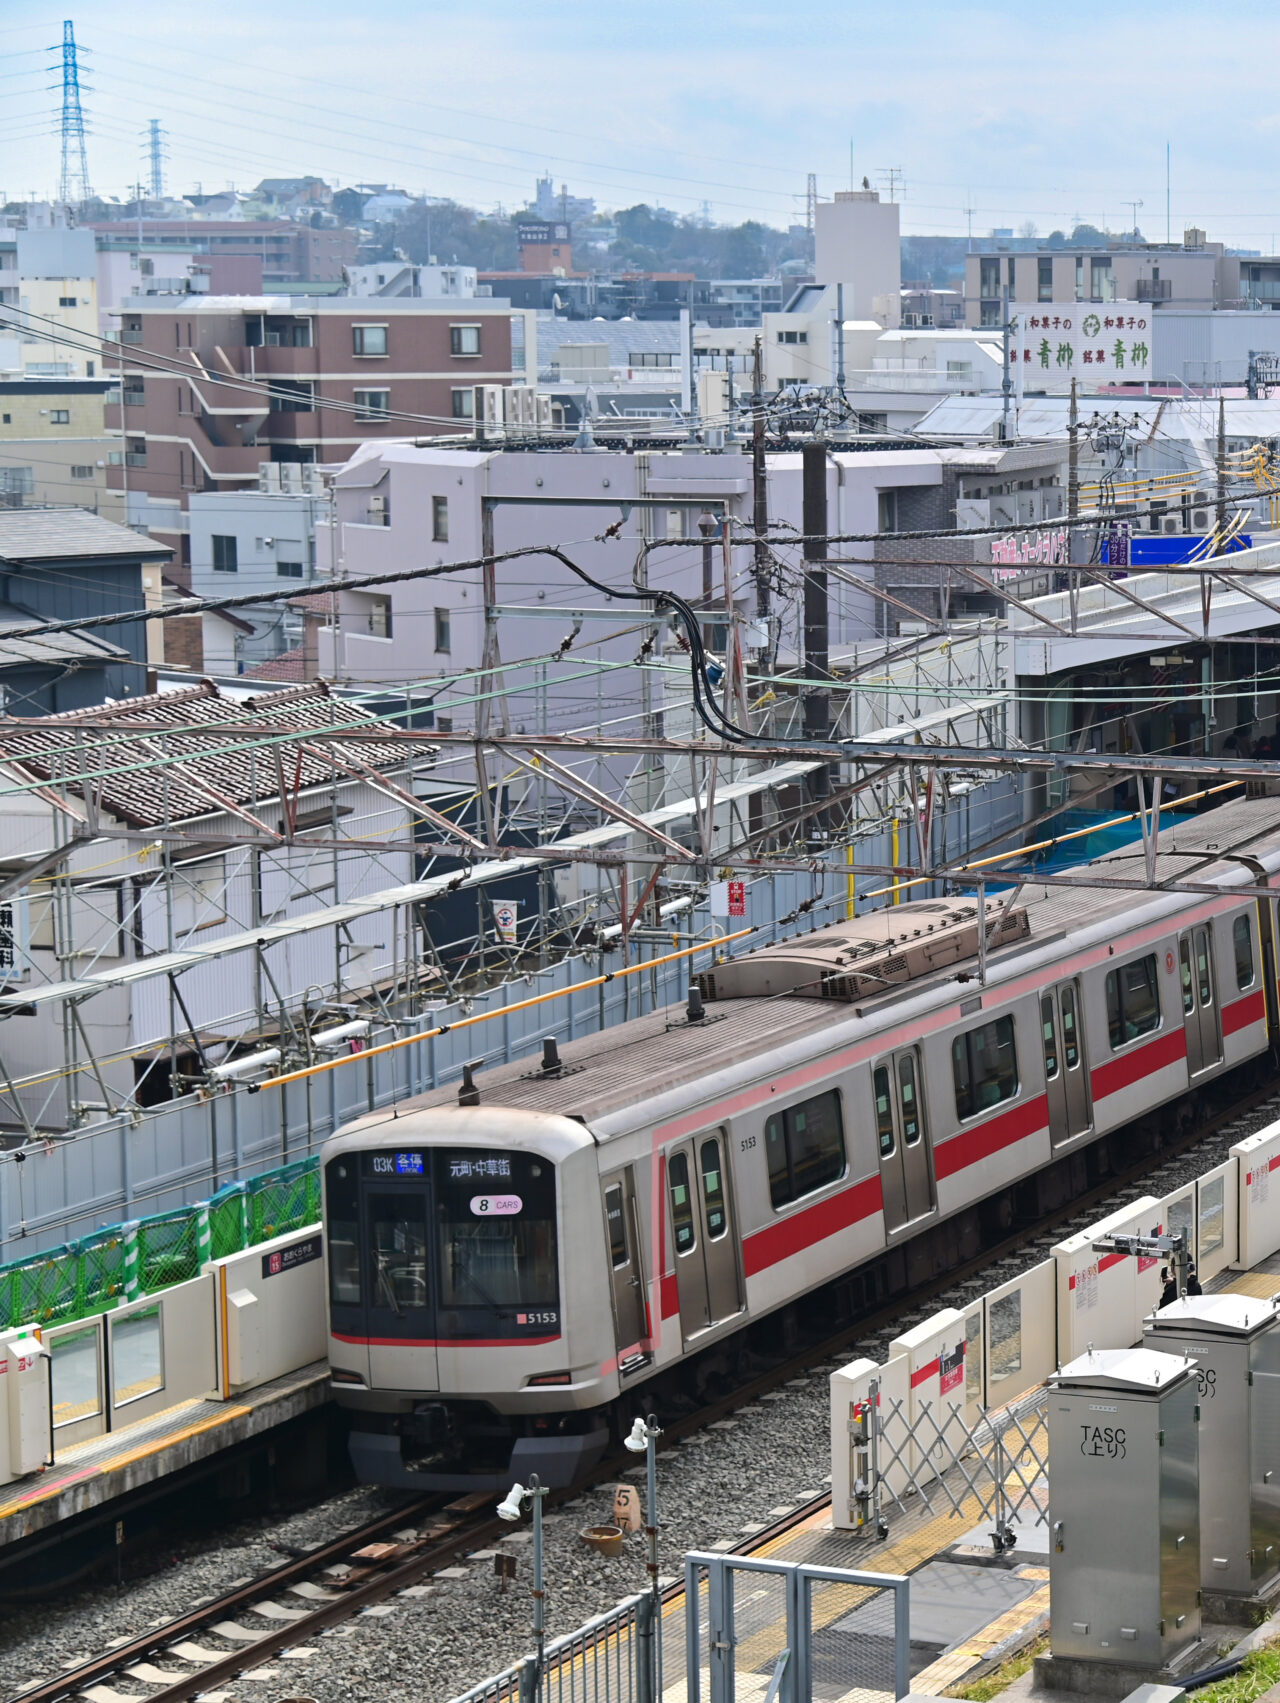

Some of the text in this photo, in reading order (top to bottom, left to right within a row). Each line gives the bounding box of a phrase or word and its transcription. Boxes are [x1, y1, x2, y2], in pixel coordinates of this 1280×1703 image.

[1029, 315, 1072, 330] 和菓子の
[1103, 315, 1147, 330] 和菓子の
[741, 1135, 756, 1152] 5153
[373, 1156, 394, 1172] 03K
[398, 1153, 422, 1168] 各停
[450, 1159, 510, 1177] 元町・中華街
[479, 1199, 519, 1212] 8 CARS
[528, 1313, 557, 1324] 5153
[1196, 1368, 1216, 1384] SC
[1080, 1425, 1126, 1444] TASC
[617, 1489, 631, 1506] 5
